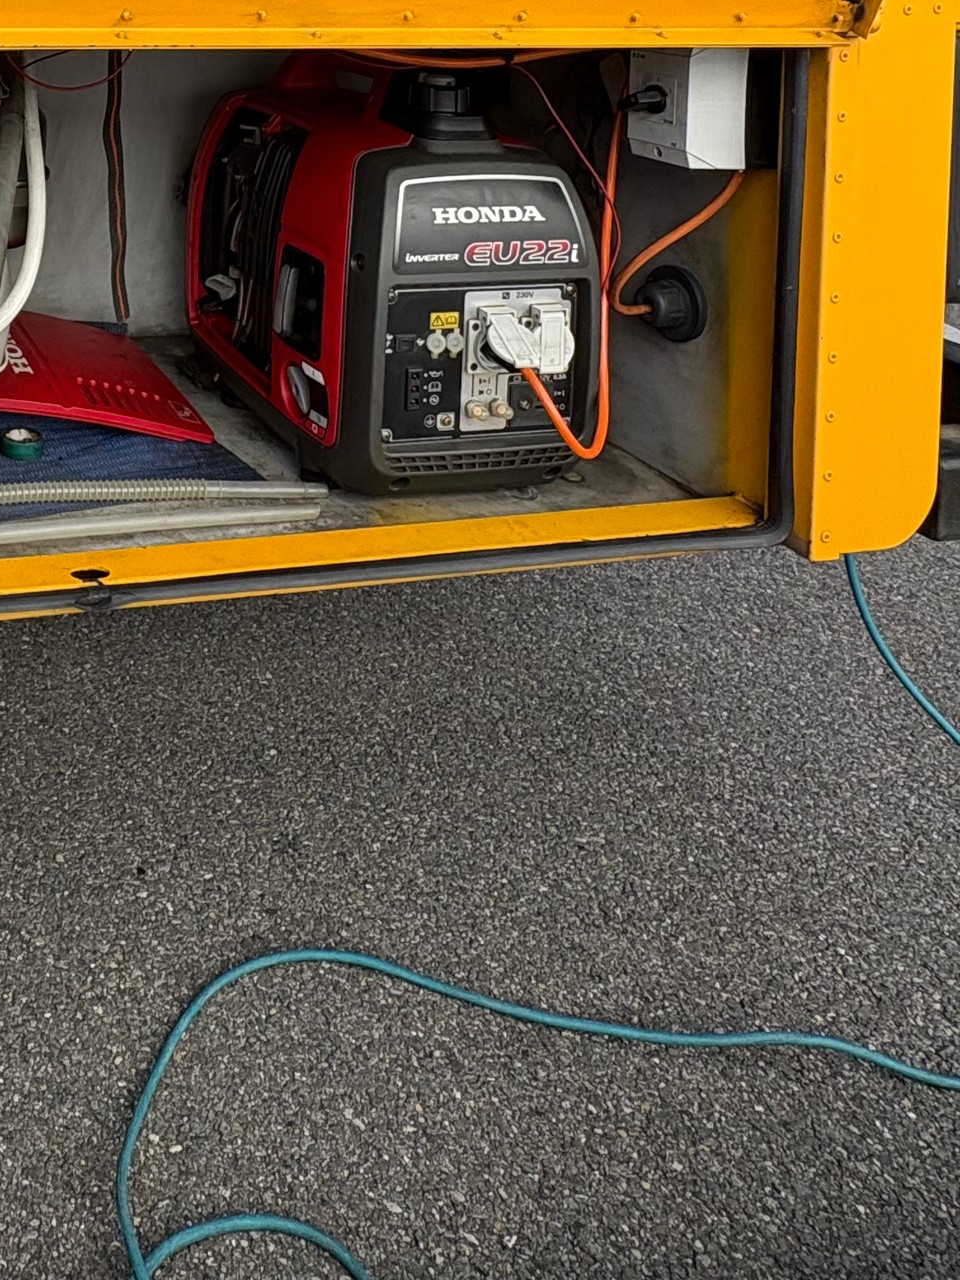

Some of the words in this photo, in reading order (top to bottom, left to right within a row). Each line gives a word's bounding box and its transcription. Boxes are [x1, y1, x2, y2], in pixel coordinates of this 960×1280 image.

[432, 205, 546, 224] HONDA
[464, 239, 579, 266] EU22i
[515, 291, 535, 299] 230V
